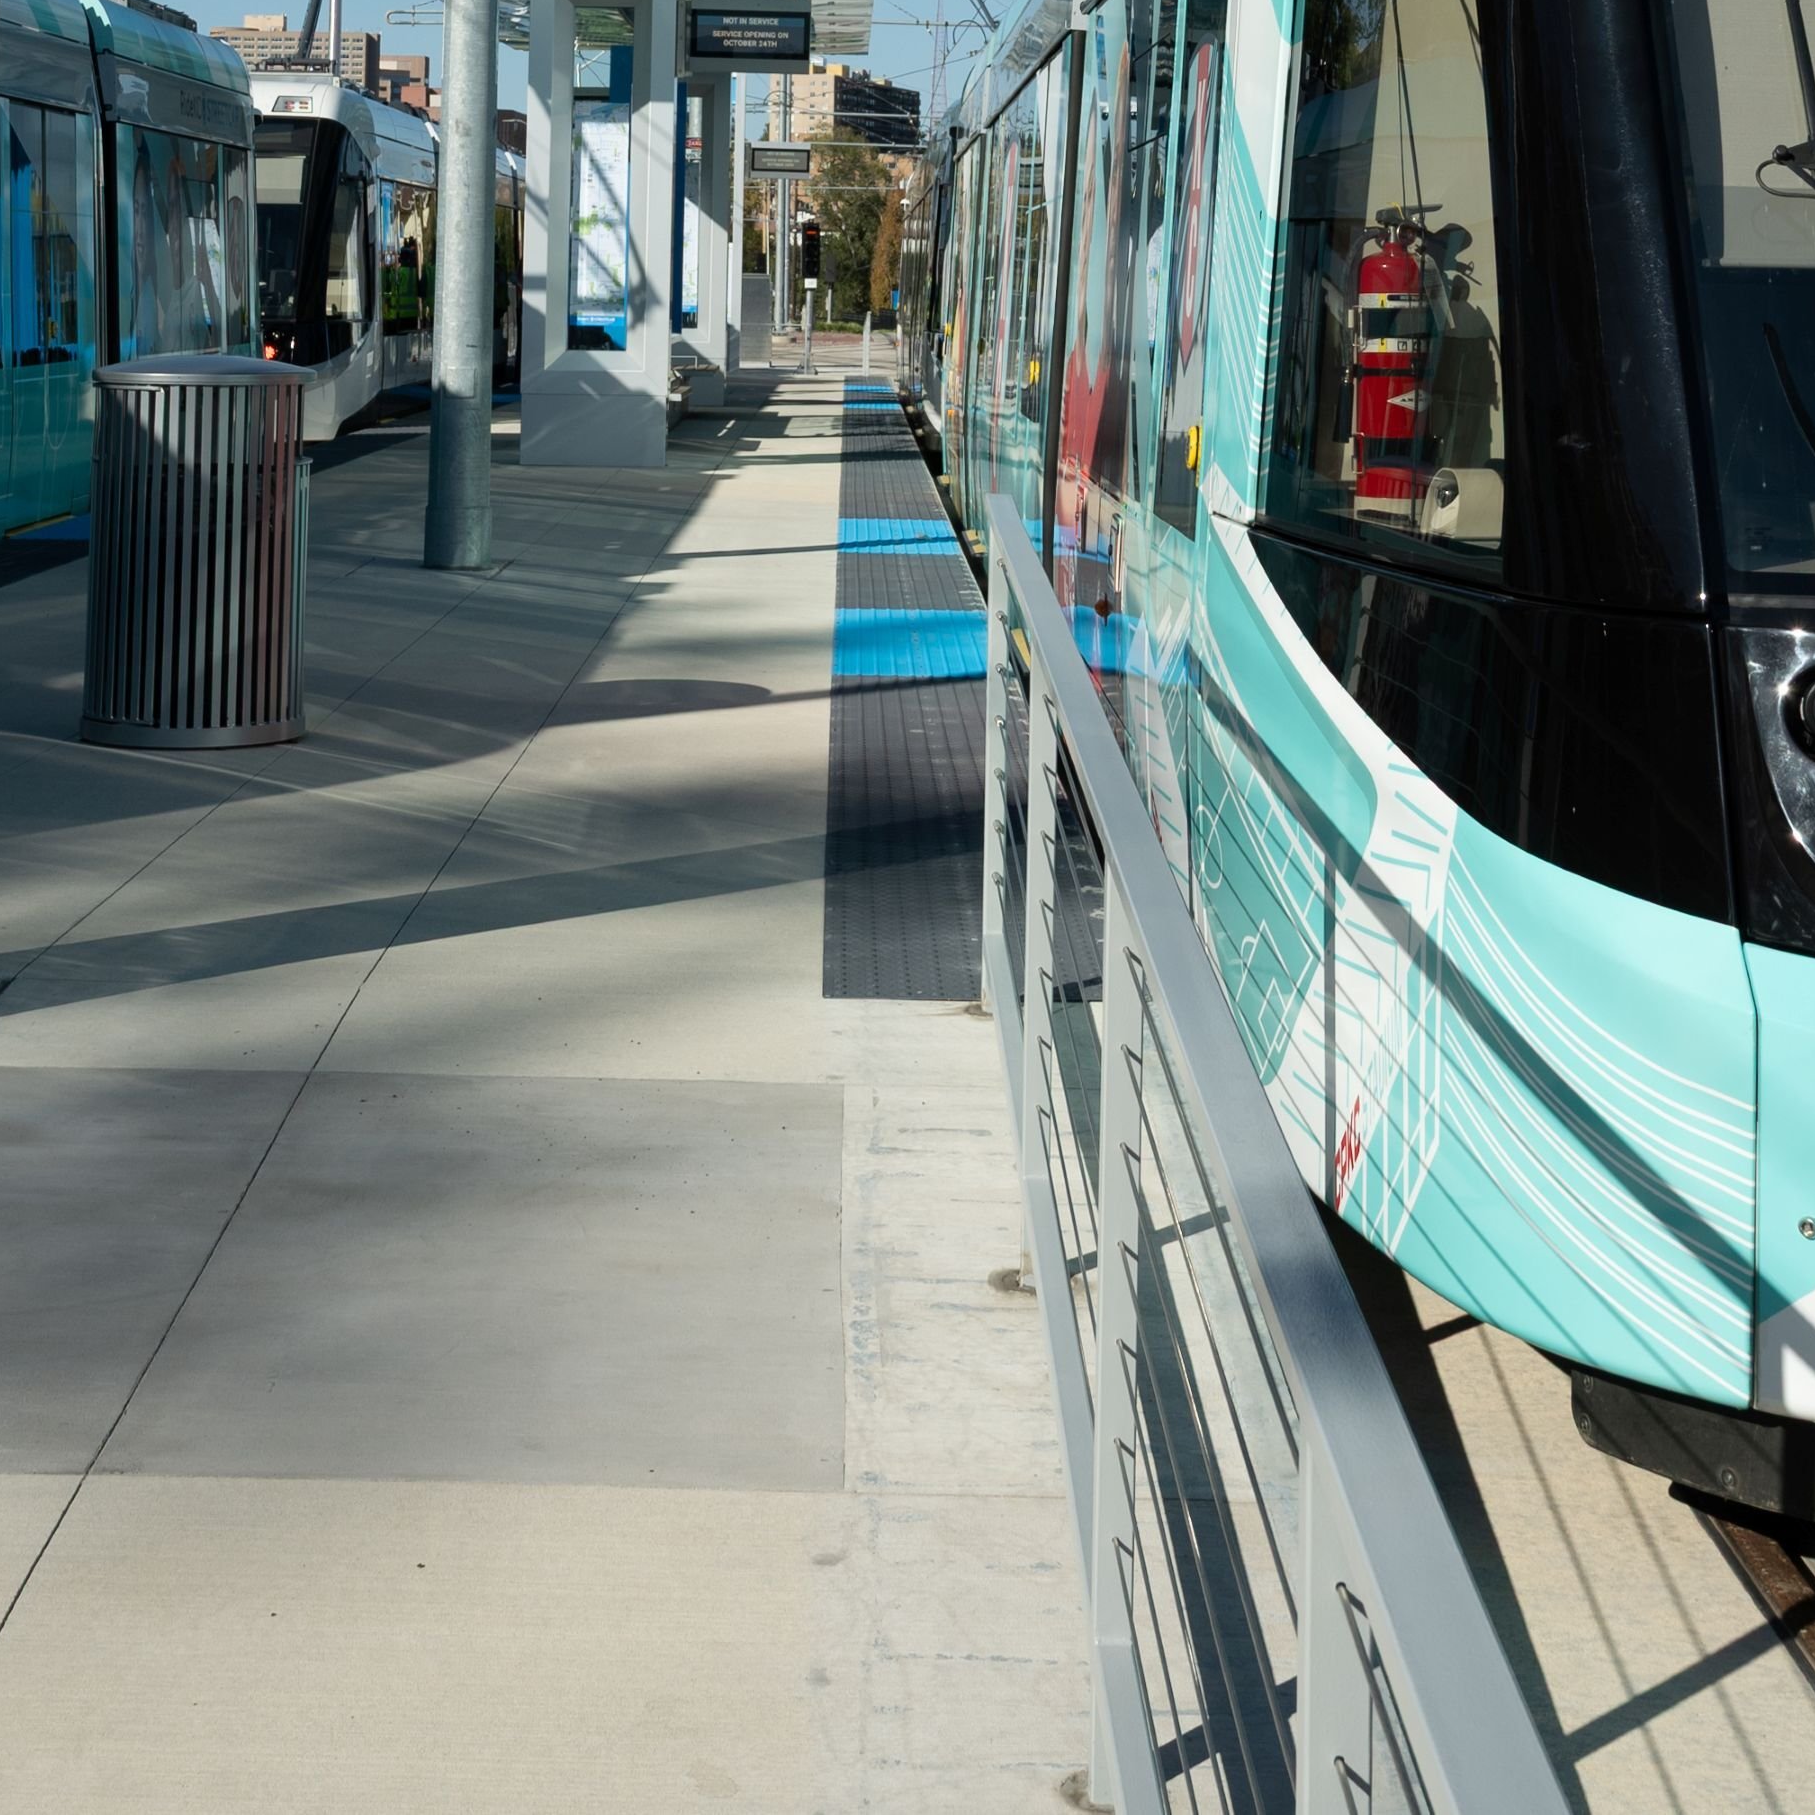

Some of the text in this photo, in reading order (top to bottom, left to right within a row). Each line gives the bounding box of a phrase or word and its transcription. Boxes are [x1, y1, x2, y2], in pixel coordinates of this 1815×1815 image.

[723, 17, 738, 25] NOT
[749, 18, 779, 26] SERVICE
[712, 30, 742, 38] SERVICE
[744, 31, 776, 39] OPENING
[723, 39, 757, 47] OCTOBER
